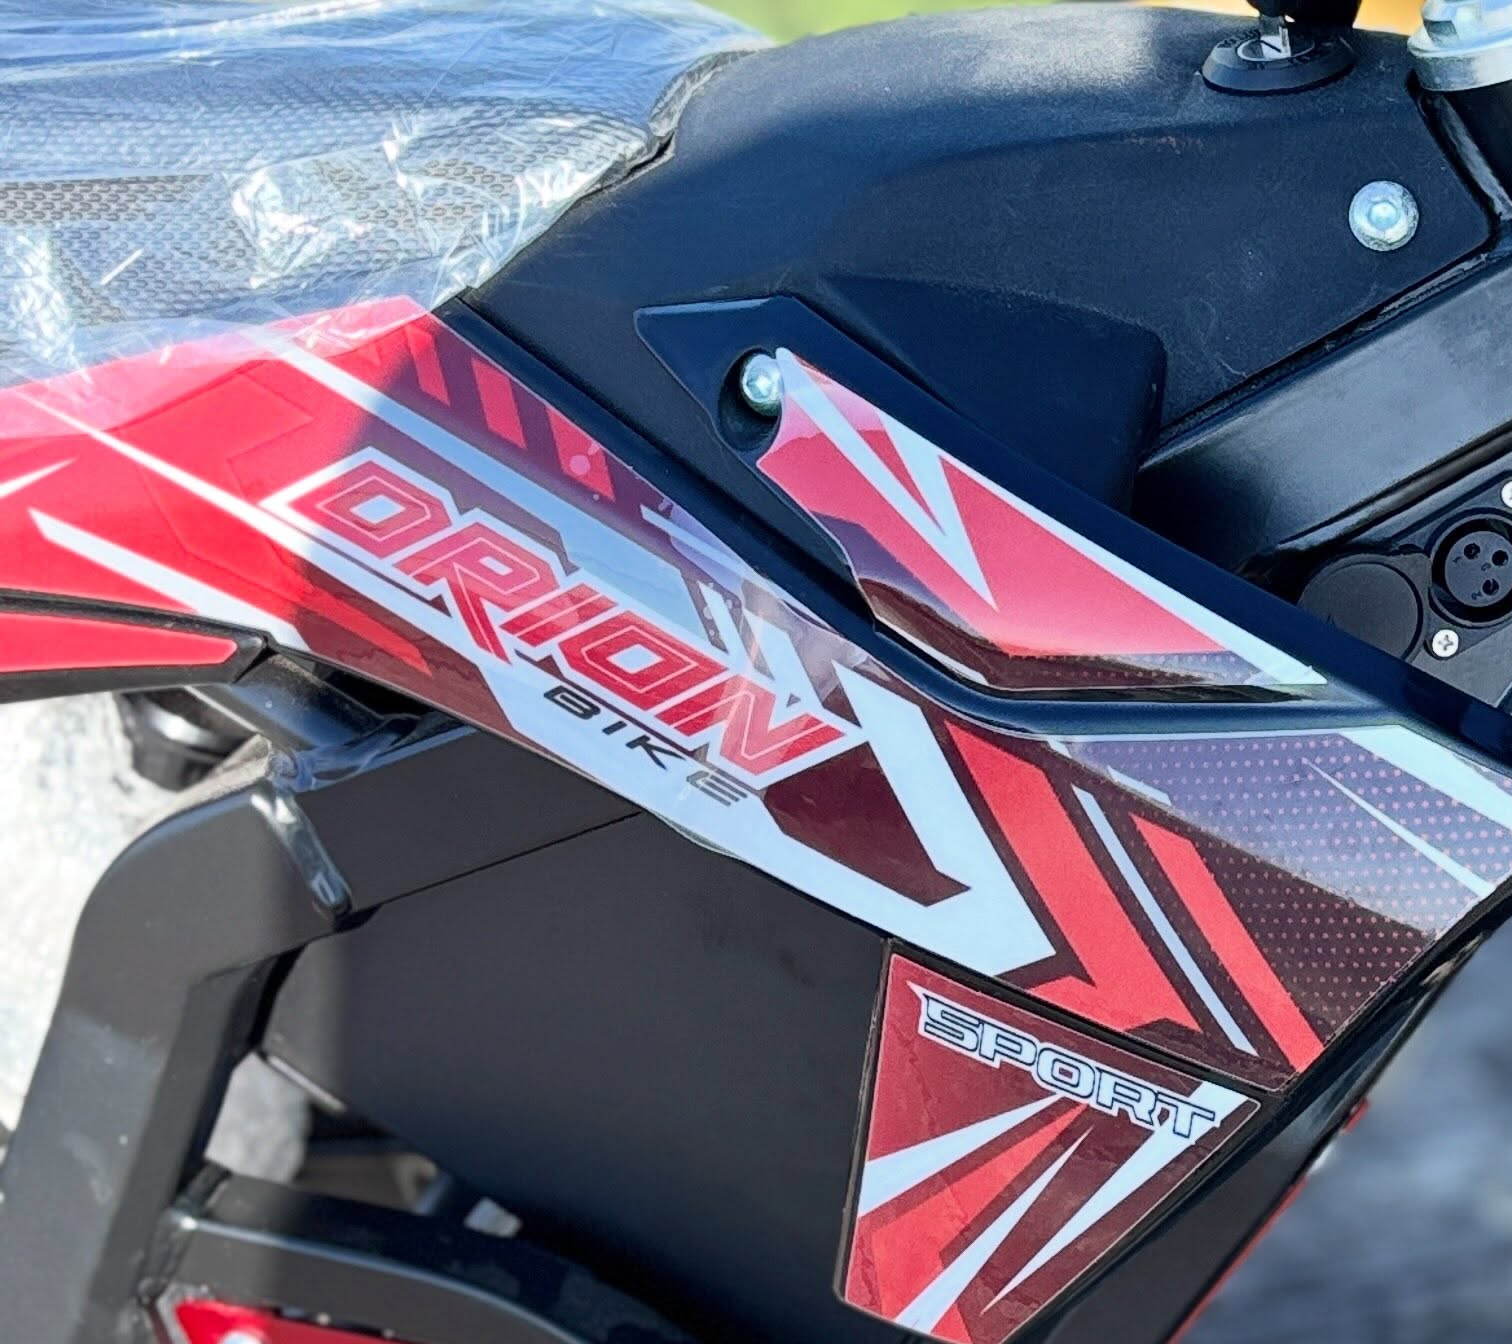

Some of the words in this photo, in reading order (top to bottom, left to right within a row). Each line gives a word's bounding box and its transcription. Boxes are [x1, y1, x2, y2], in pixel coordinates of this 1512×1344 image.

[280, 457, 848, 777] ORION
[541, 683, 749, 807] BIKE
[920, 993, 1217, 1140] SPORT
